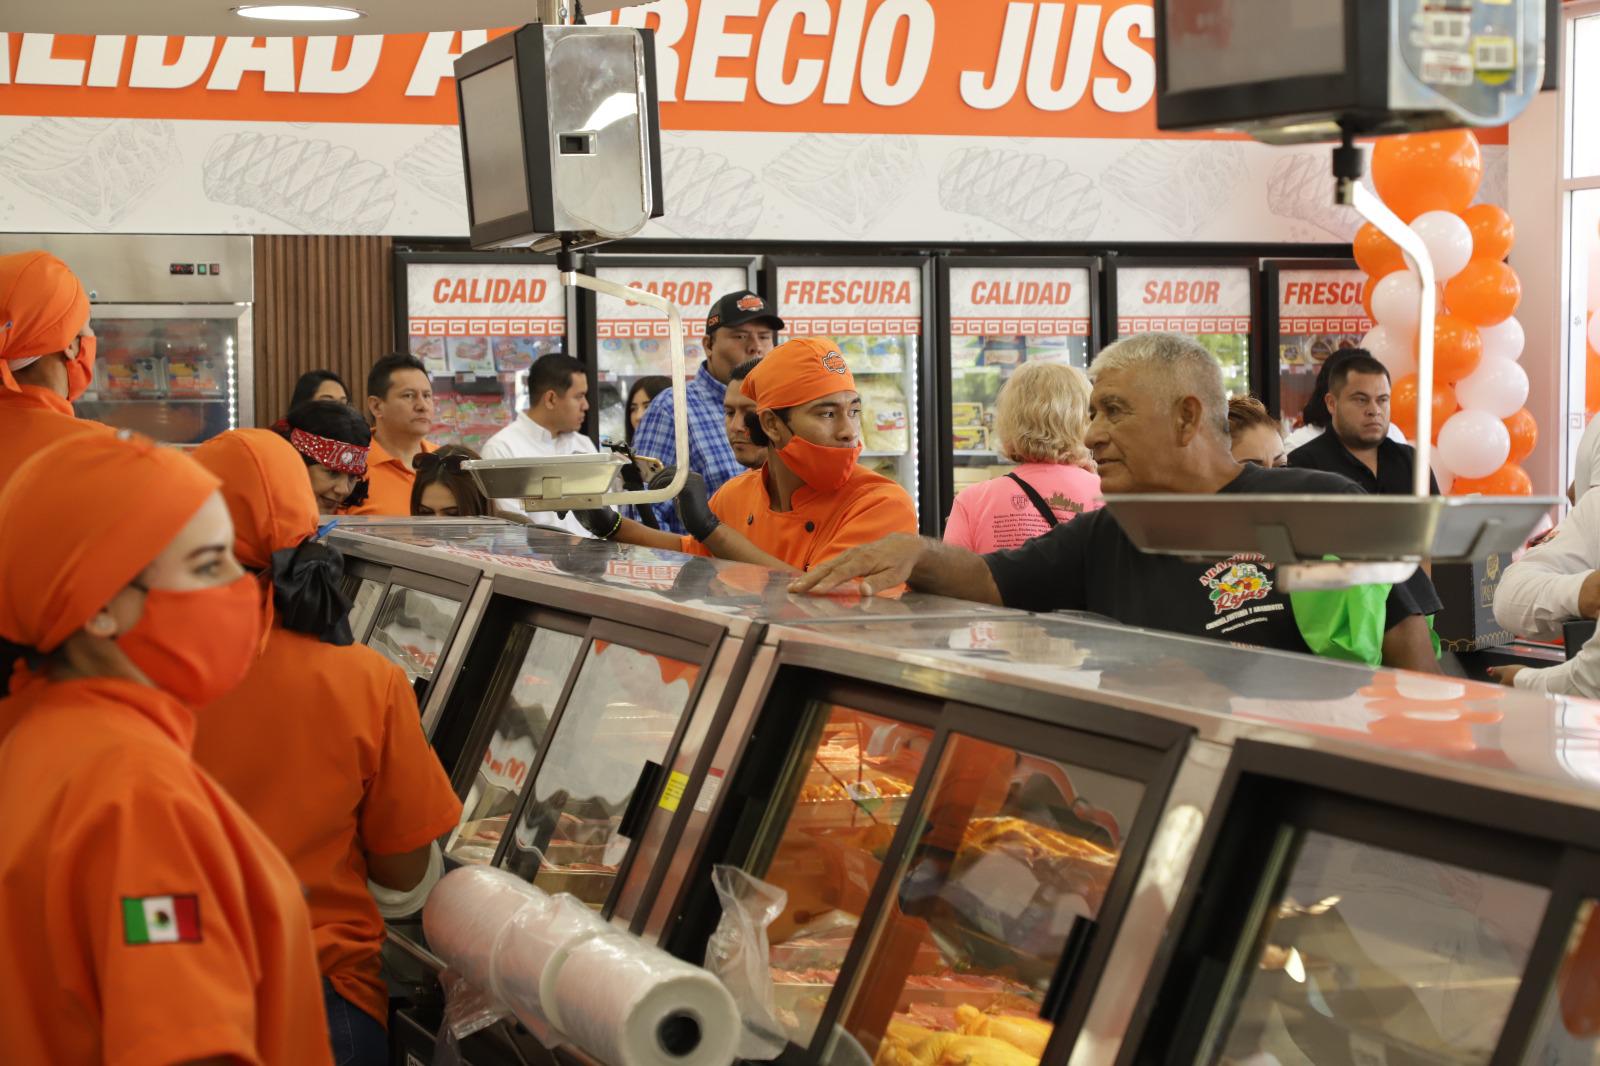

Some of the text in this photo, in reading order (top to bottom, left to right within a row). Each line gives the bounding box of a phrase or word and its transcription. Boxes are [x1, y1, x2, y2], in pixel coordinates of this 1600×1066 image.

[0, 31, 385, 94] LIDAD
[584, 0, 936, 106] RECIO
[433, 278, 547, 304] CALIDAD
[784, 281, 911, 304] FRESCURA
[971, 281, 1072, 305] CALIDAD
[1142, 281, 1220, 305] SABOR
